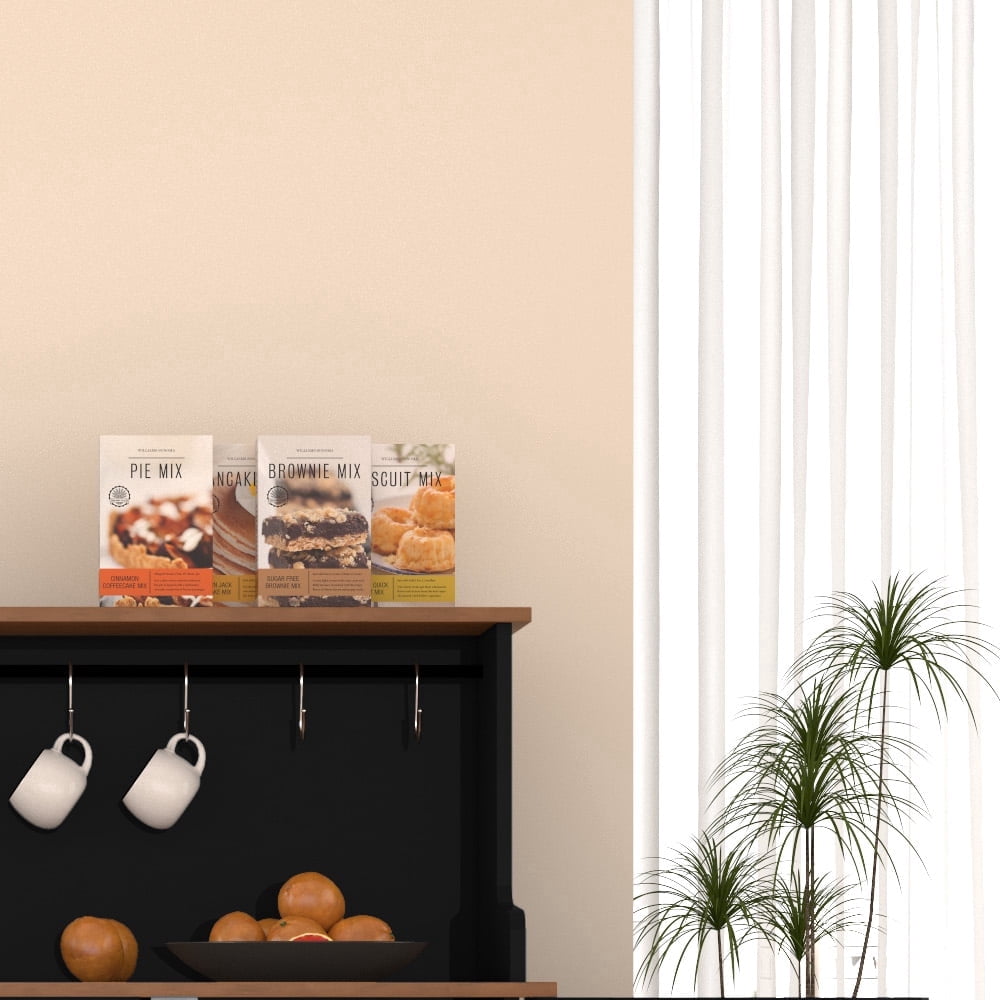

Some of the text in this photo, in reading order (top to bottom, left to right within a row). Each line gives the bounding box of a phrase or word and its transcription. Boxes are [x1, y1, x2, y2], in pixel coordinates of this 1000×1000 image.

[130, 463, 183, 479] PIE MIX
[268, 463, 361, 479] BROWNIE MIX
[419, 471, 442, 487] MIX
